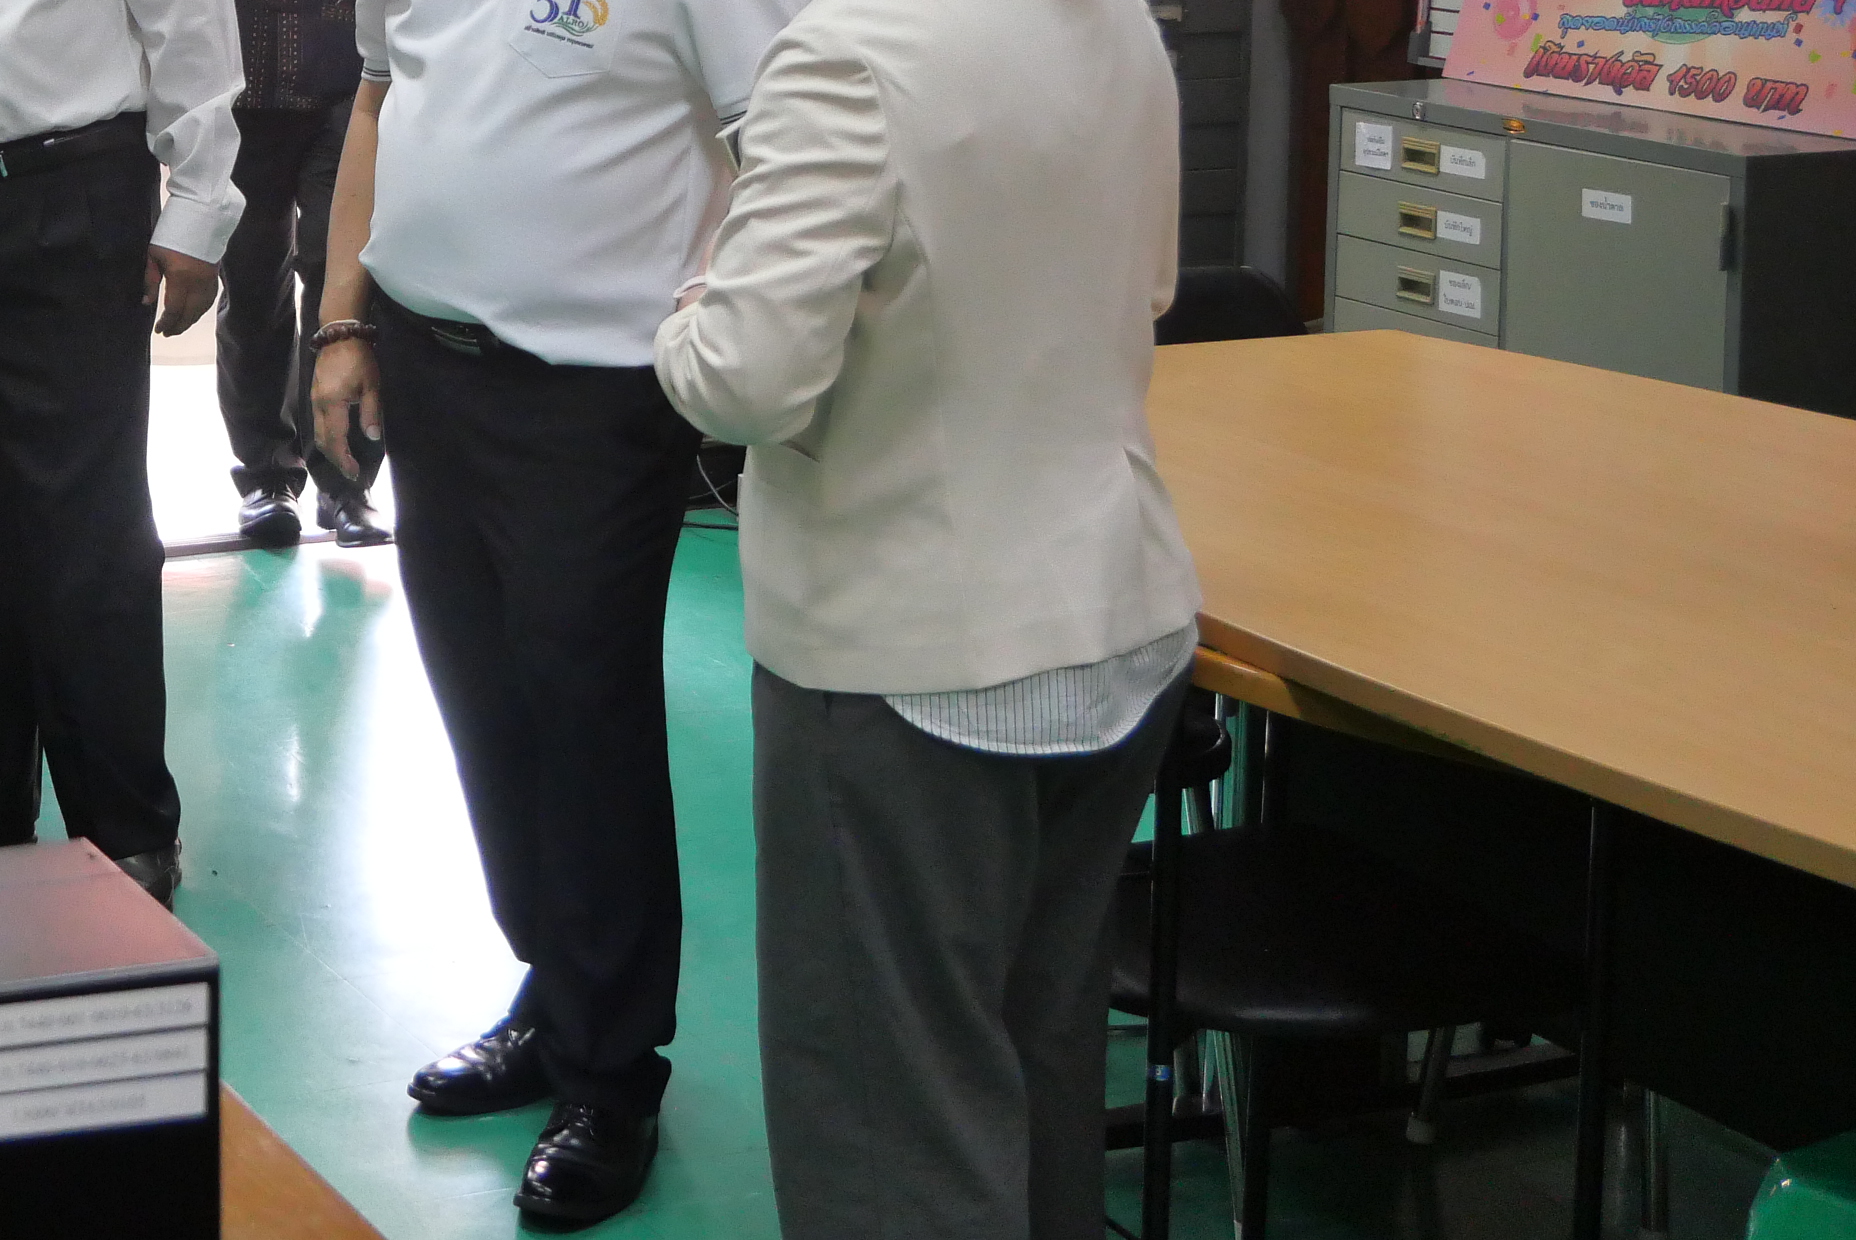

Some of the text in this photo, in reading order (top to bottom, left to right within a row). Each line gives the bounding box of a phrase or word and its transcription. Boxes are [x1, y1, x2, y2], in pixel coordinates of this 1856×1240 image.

[557, 15, 585, 29] ALRO
[1667, 64, 1737, 103] 1500
[1743, 77, 1810, 116] บาท
